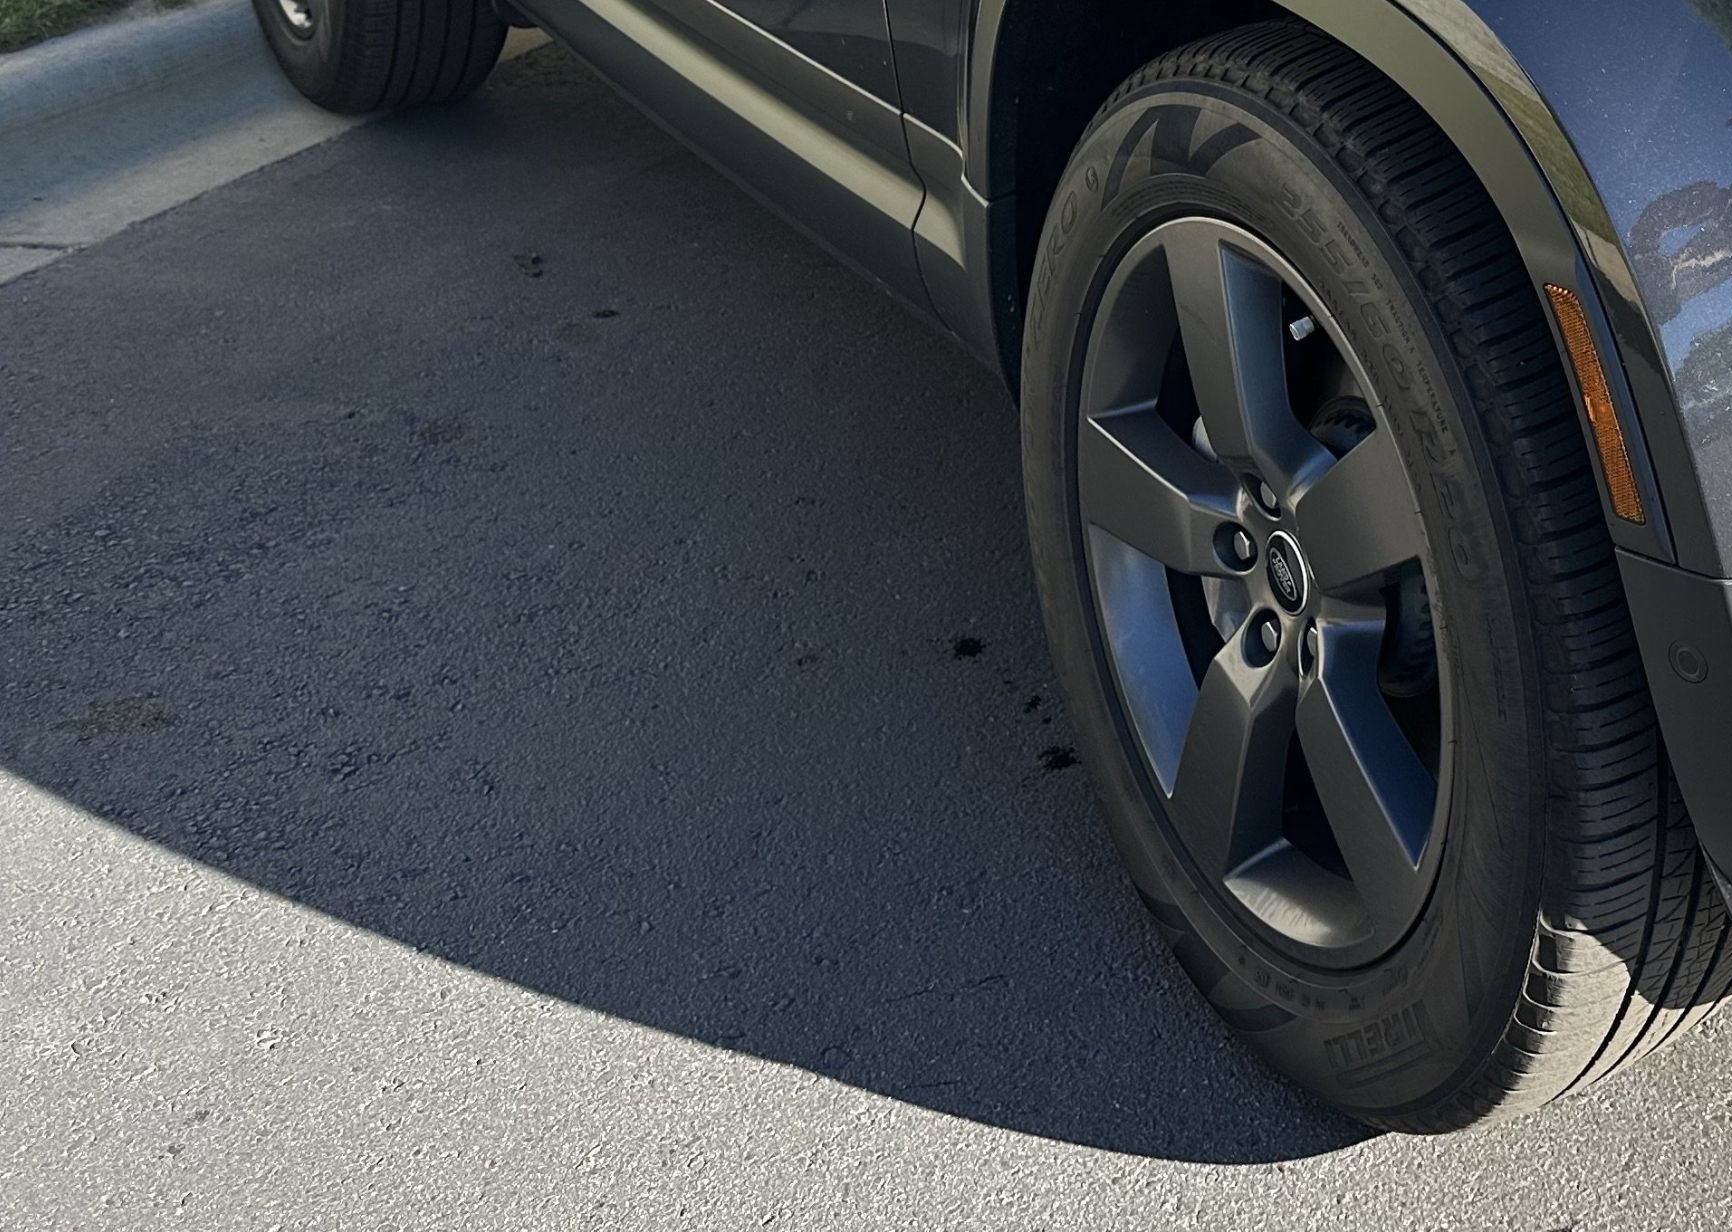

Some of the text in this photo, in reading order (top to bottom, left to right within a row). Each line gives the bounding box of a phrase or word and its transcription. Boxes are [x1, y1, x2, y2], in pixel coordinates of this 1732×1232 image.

[1030, 190, 1077, 352] ZERO
[1386, 299, 1410, 344] TRACTION
[1416, 360, 1449, 434] TEMPERATURE
[1324, 1000, 1442, 1089] PIRELLI
